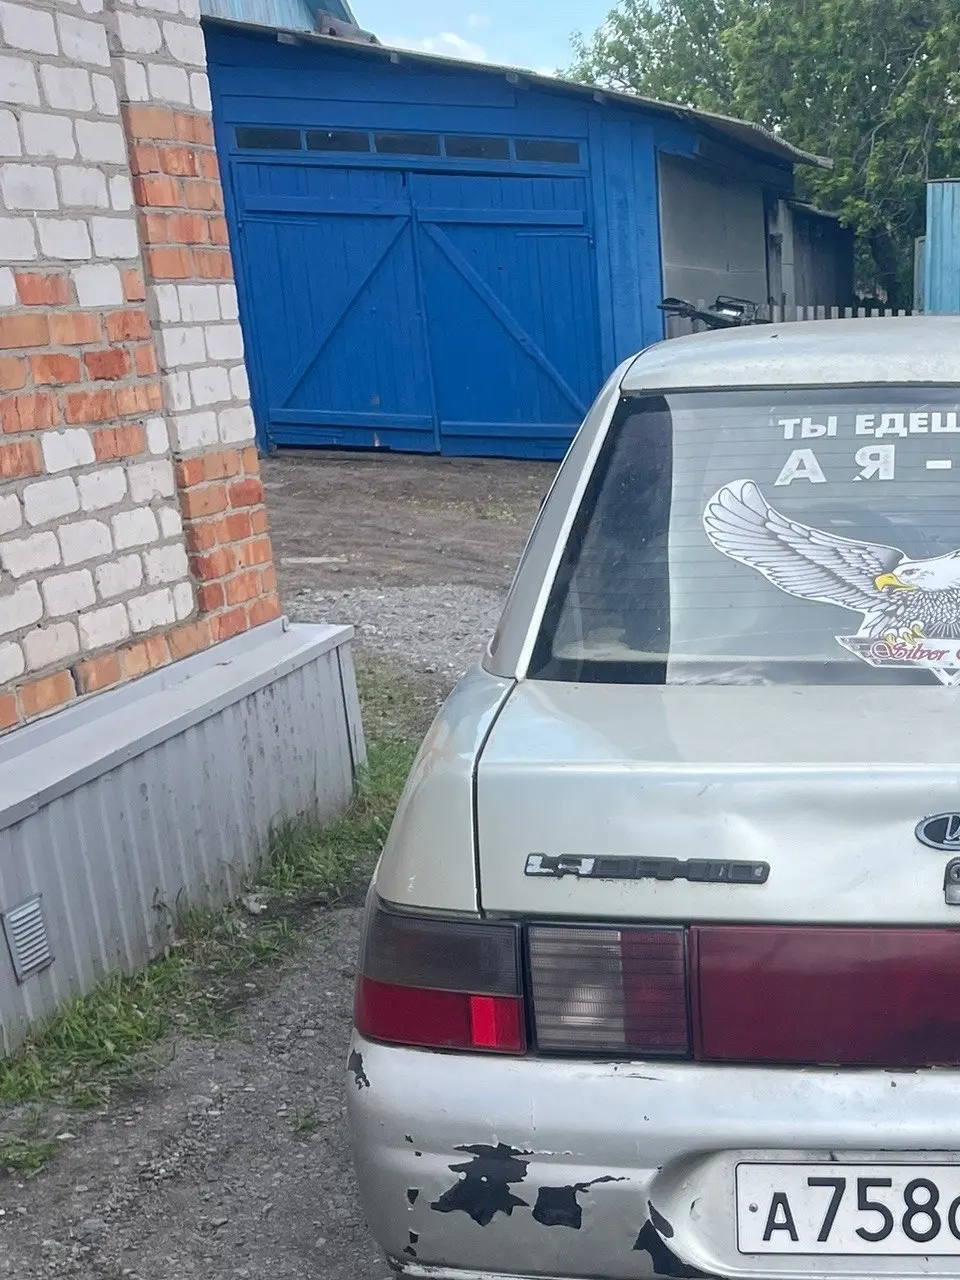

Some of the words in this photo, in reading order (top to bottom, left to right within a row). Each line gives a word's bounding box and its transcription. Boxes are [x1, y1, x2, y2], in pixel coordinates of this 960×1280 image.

[778, 415, 838, 440] ТЫ
[773, 448, 827, 487] А
[852, 444, 895, 482] Я
